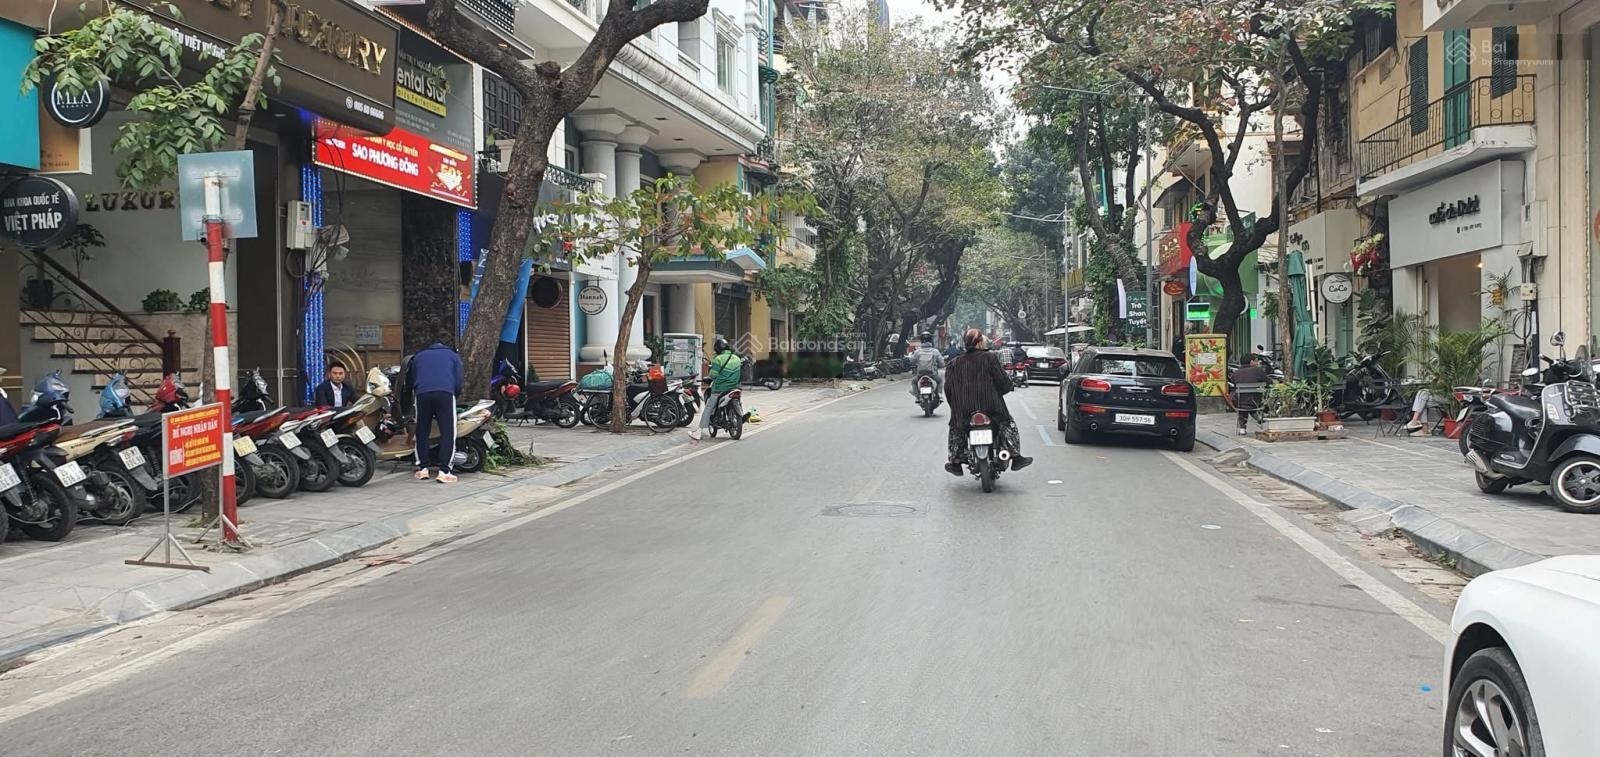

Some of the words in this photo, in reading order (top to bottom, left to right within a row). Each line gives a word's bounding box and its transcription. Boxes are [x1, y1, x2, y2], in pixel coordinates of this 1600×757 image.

[184, 34, 201, 52] VIỆT
[396, 66, 425, 95] ental
[352, 142, 369, 161] SAO
[17, 195, 33, 207] KHOA
[33, 191, 50, 205] QUỐC
[51, 190, 60, 204] TẾ
[85, 191, 179, 213] LUXUR
[4, 211, 29, 235] VIỆT
[31, 208, 63, 230] PHÁP
